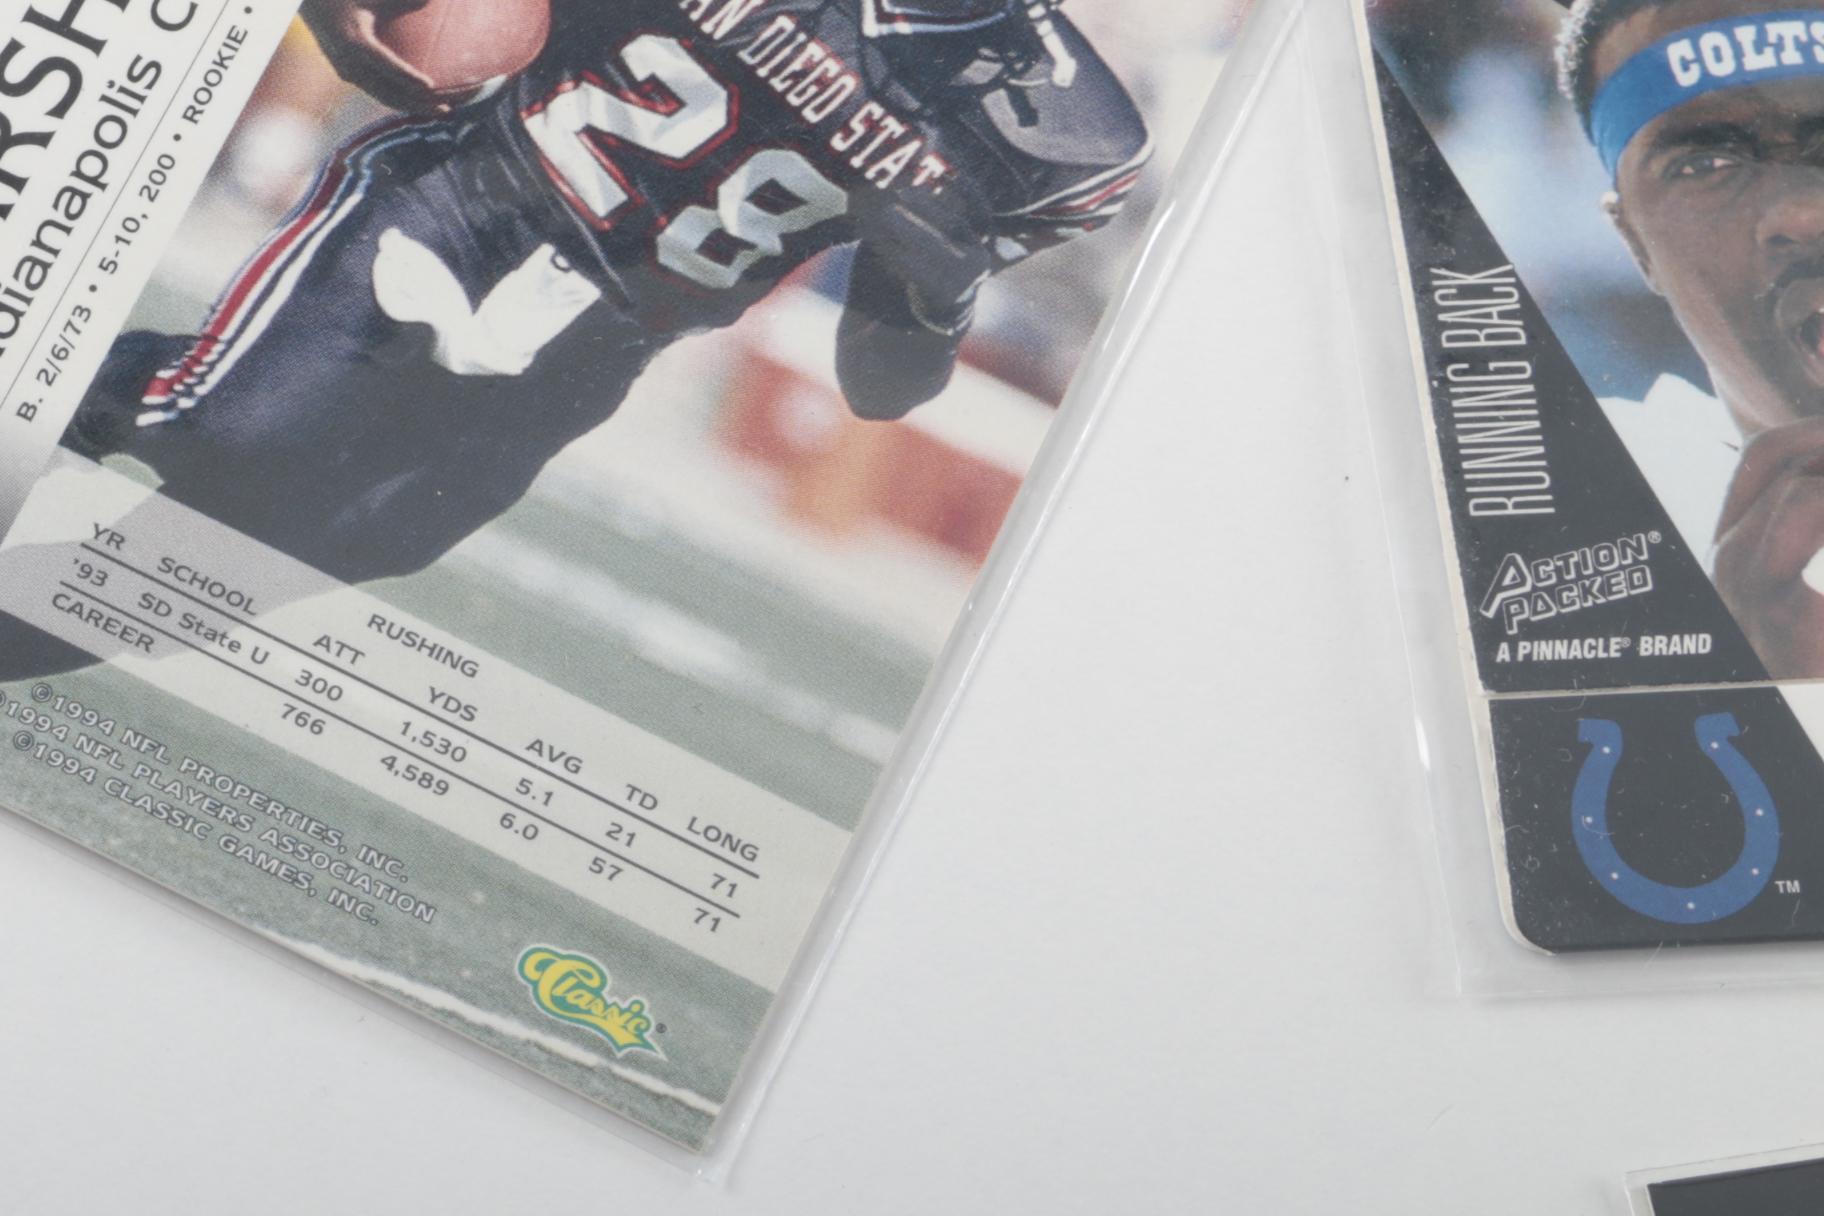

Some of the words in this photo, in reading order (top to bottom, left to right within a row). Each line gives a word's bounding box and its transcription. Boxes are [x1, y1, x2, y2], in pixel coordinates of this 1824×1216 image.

[736, 14, 862, 124] DIEGO
[15, 397, 43, 423] B.
[35, 303, 92, 387] 2/6/73
[97, 212, 149, 275] 5-10,
[138, 152, 176, 203] 200
[181, 24, 249, 125] ROOKIE
[1430, 264, 1527, 348] BACK
[1446, 361, 1555, 516] RUNNING
[366, 613, 479, 679] RUSHING
[1496, 641, 1511, 663] A
[1639, 633, 1713, 657] BRAND
[1503, 565, 1653, 635] PACKED
[50, 592, 155, 654] CAREER
[281, 702, 326, 736] 766
[379, 755, 450, 796] 4,589
[499, 812, 539, 841] 6.0
[588, 855, 623, 881] 57
[693, 907, 721, 933] 71
[92, 522, 126, 552] YR
[155, 555, 257, 617] SCHOOL
[312, 634, 365, 665] ATT
[429, 685, 478, 722] YDS
[524, 738, 583, 775] AVG
[625, 783, 658, 811] TD
[686, 815, 759, 863] LONG
[136, 590, 173, 618] SD
[176, 611, 242, 654] State
[250, 645, 270, 665] U
[294, 668, 343, 702] 300
[400, 721, 467, 763] 1,530
[514, 777, 554, 807] 5.1
[604, 821, 636, 848] 21
[710, 872, 738, 899] 71
[72, 730, 128, 775] NFL
[130, 759, 254, 838] PLAYERS
[256, 821, 437, 929] ASSOCIATION
[100, 773, 213, 847] CLASSIC
[215, 830, 325, 902] GAMES,
[324, 884, 383, 931] INC.
[118, 724, 174, 769] NFL
[177, 753, 352, 858] PROPERTIES,
[353, 840, 413, 887] INC.
